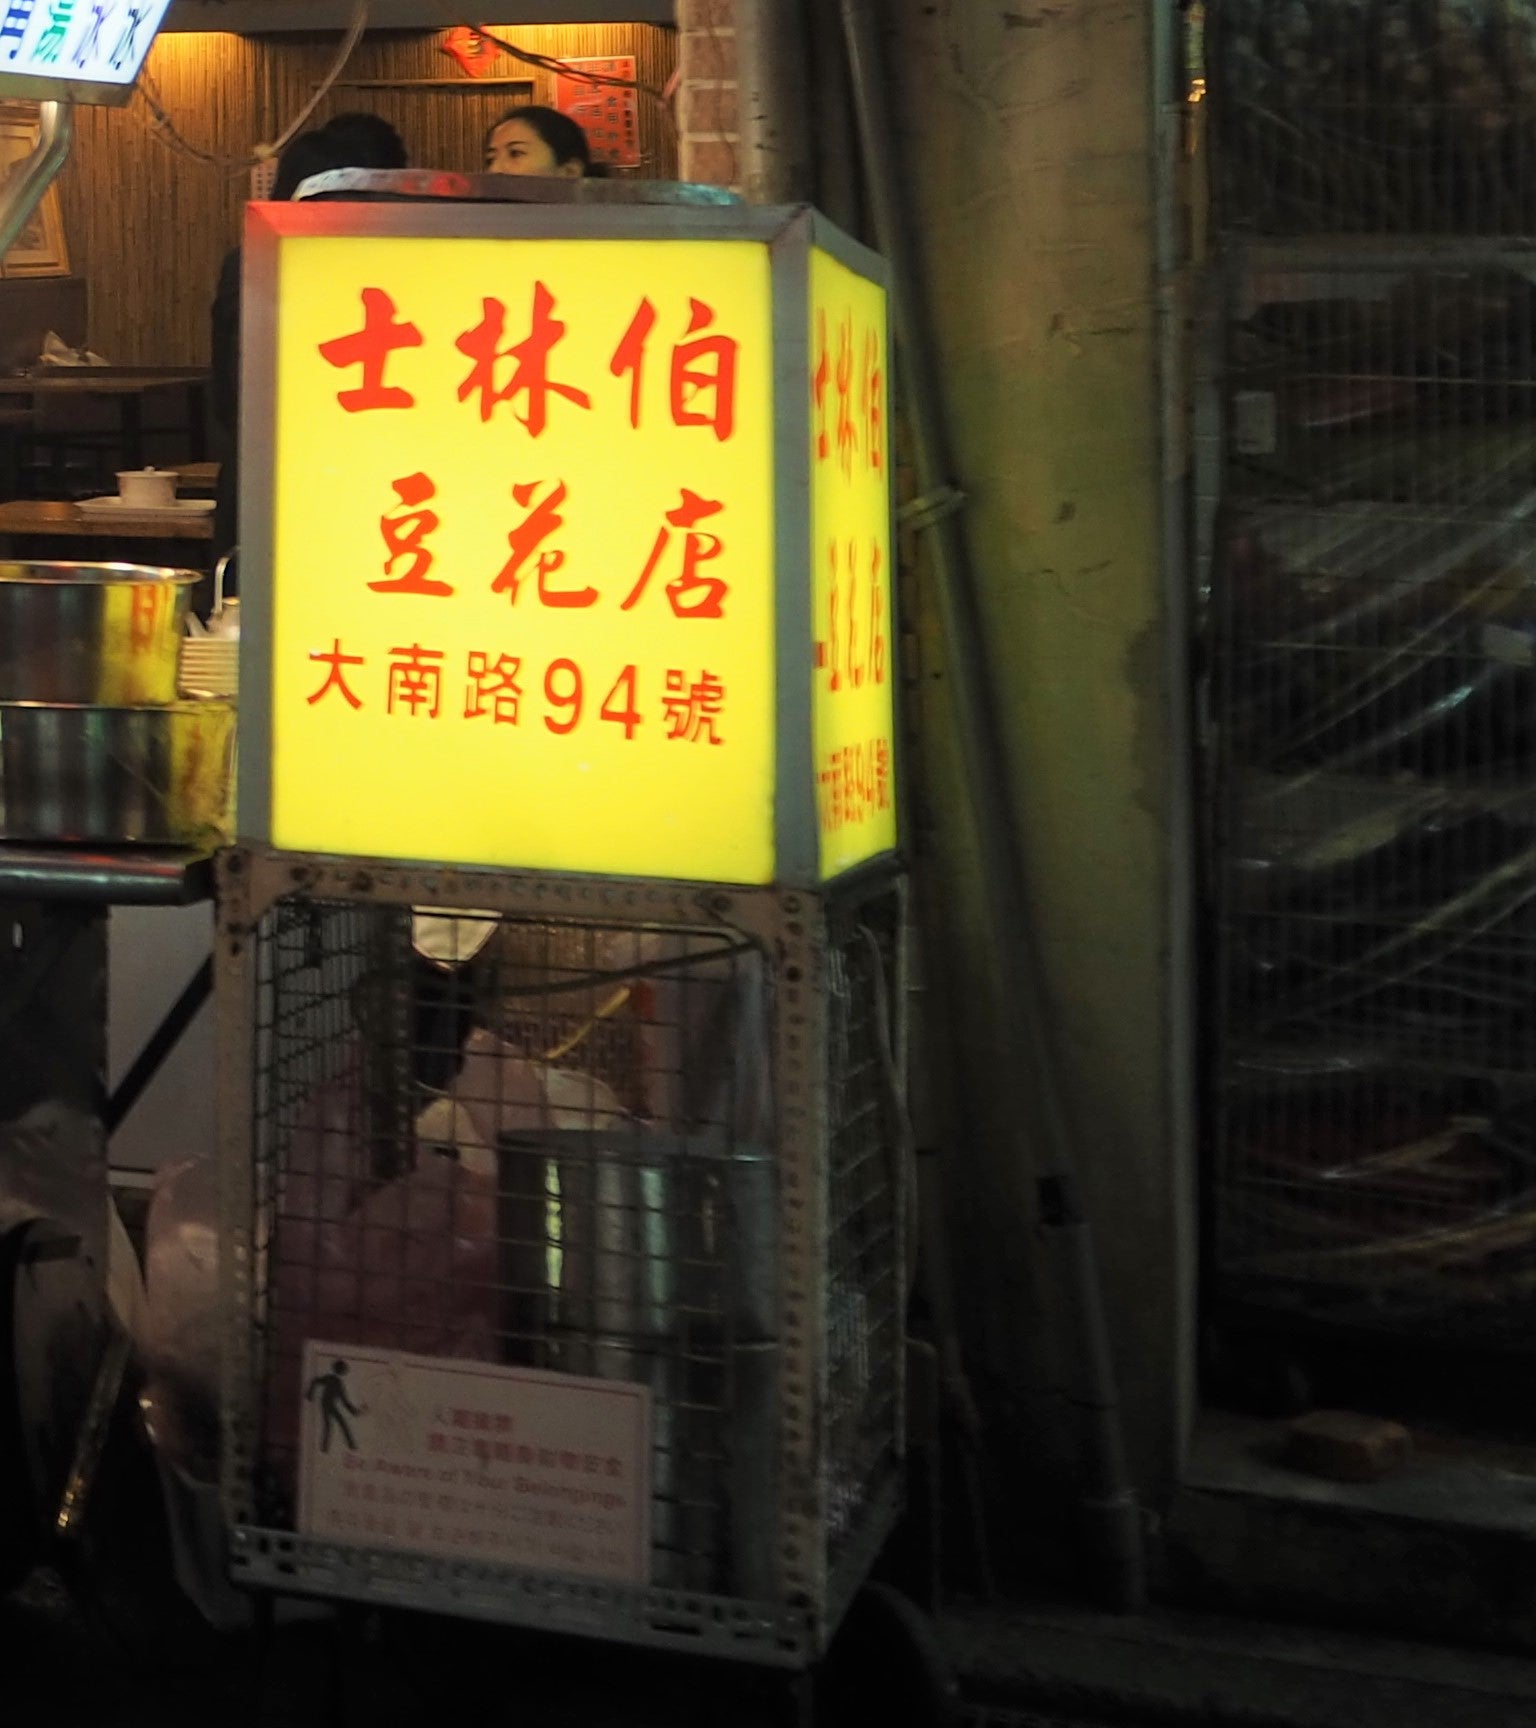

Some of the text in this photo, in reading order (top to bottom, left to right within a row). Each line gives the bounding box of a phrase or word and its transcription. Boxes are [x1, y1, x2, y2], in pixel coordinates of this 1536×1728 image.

[316, 279, 740, 443] 士林伯
[366, 471, 732, 621] 豆花店
[305, 637, 727, 747] 大南路94號
